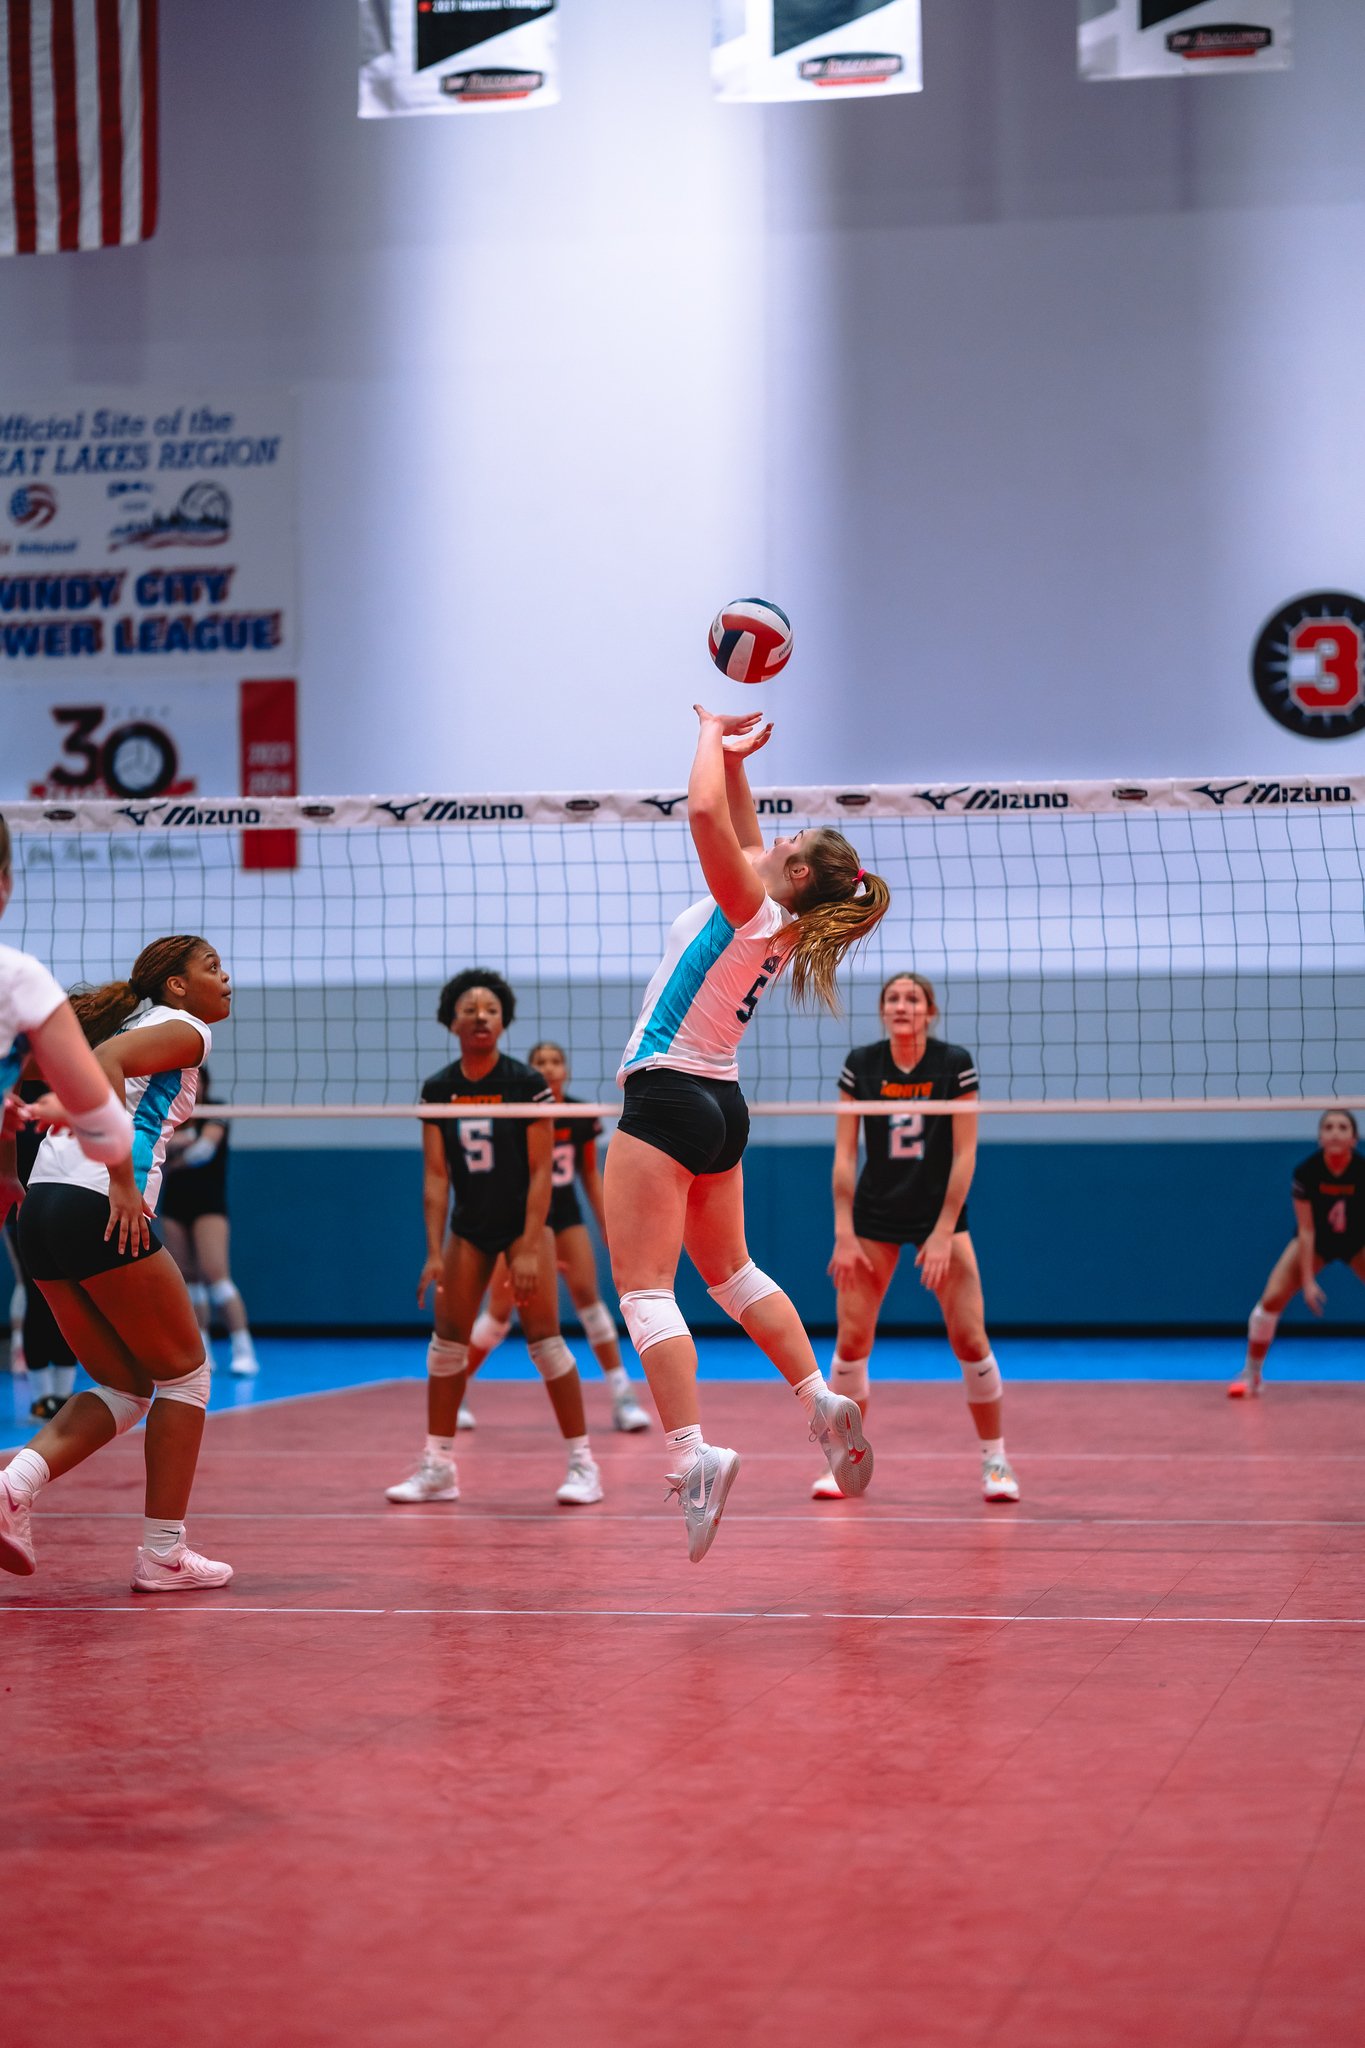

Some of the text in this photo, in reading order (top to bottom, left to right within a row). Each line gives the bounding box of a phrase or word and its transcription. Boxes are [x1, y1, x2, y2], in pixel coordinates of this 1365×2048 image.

[0, 406, 235, 442] fficial Site of the
[53, 442, 150, 475] LAKES
[158, 436, 280, 471] REGION
[135, 564, 237, 608] CITY
[114, 609, 283, 655] LEAGUE
[1289, 617, 1363, 715] 3
[735, 974, 769, 1024] 5
[458, 1117, 495, 1174] 5
[889, 1113, 924, 1160] 2
[1328, 1200, 1347, 1234] 4
